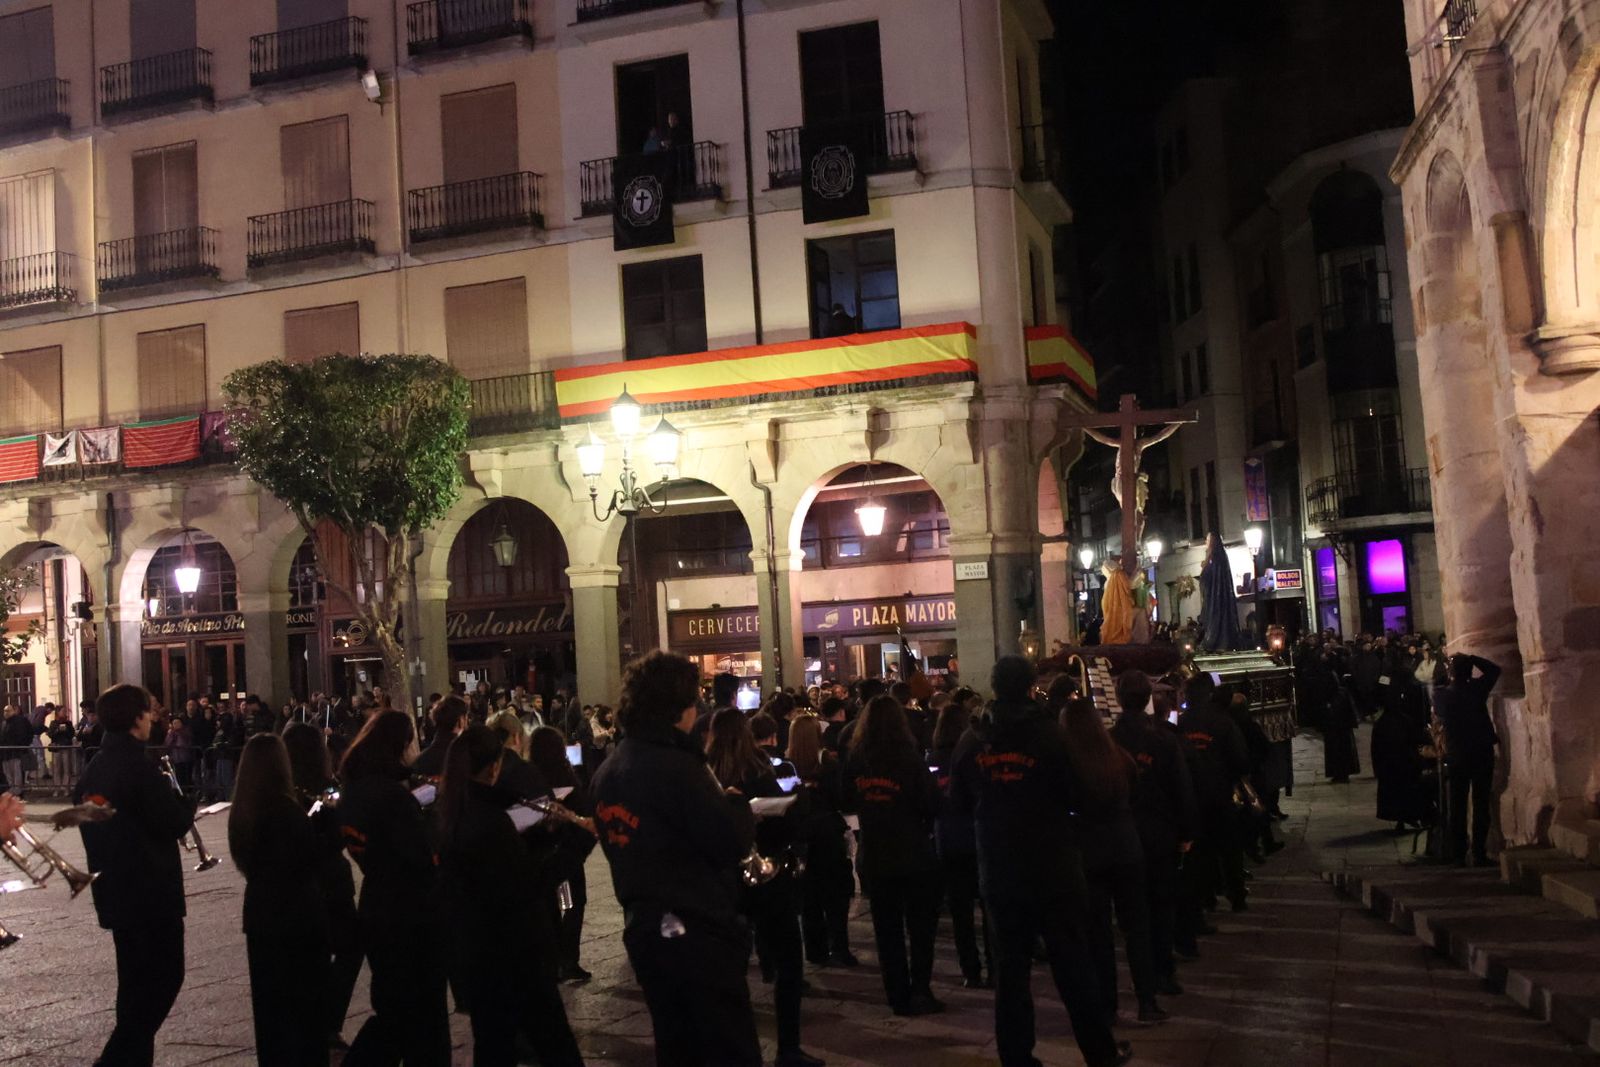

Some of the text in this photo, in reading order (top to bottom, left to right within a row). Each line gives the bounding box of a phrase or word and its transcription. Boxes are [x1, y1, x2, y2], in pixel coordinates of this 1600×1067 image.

[853, 601, 957, 626] PLAZA MAYOR
[161, 621, 176, 633] de
